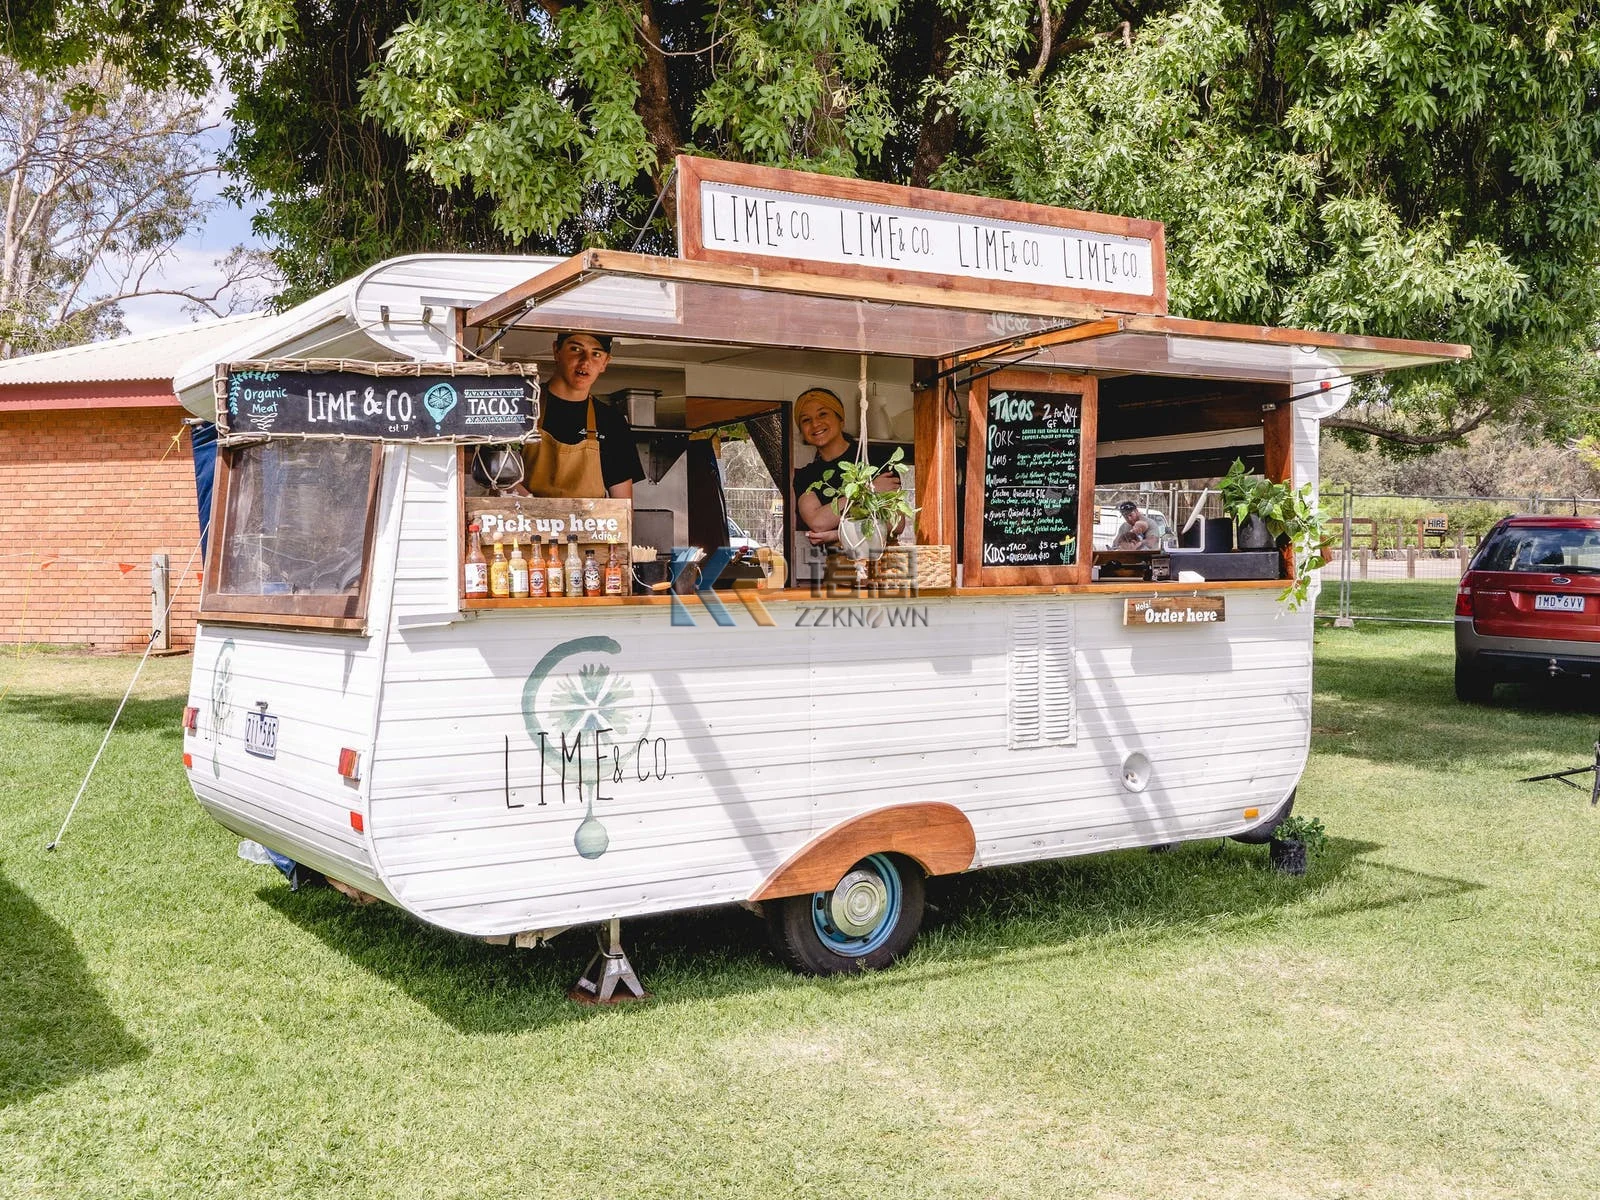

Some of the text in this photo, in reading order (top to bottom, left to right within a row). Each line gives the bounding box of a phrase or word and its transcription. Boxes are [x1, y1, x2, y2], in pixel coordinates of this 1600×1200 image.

[244, 387, 288, 403] Organic
[252, 402, 278, 414] Meat
[308, 389, 356, 422] LIME
[386, 389, 417, 421] CO.
[468, 398, 519, 415] TACOS
[989, 392, 1035, 422] TACOS
[1042, 403, 1052, 421] 2
[1053, 408, 1063, 418] for
[1047, 420, 1058, 429] GF
[988, 424, 1015, 451] PORK
[481, 513, 618, 537] Pick up here
[1427, 519, 1446, 528] HIRE
[983, 543, 1006, 564] KIDS
[1008, 542, 1027, 552] TACO
[1135, 600, 1152, 612] Hola!
[1145, 607, 1218, 623] Order here
[637, 737, 675, 783] CO.
